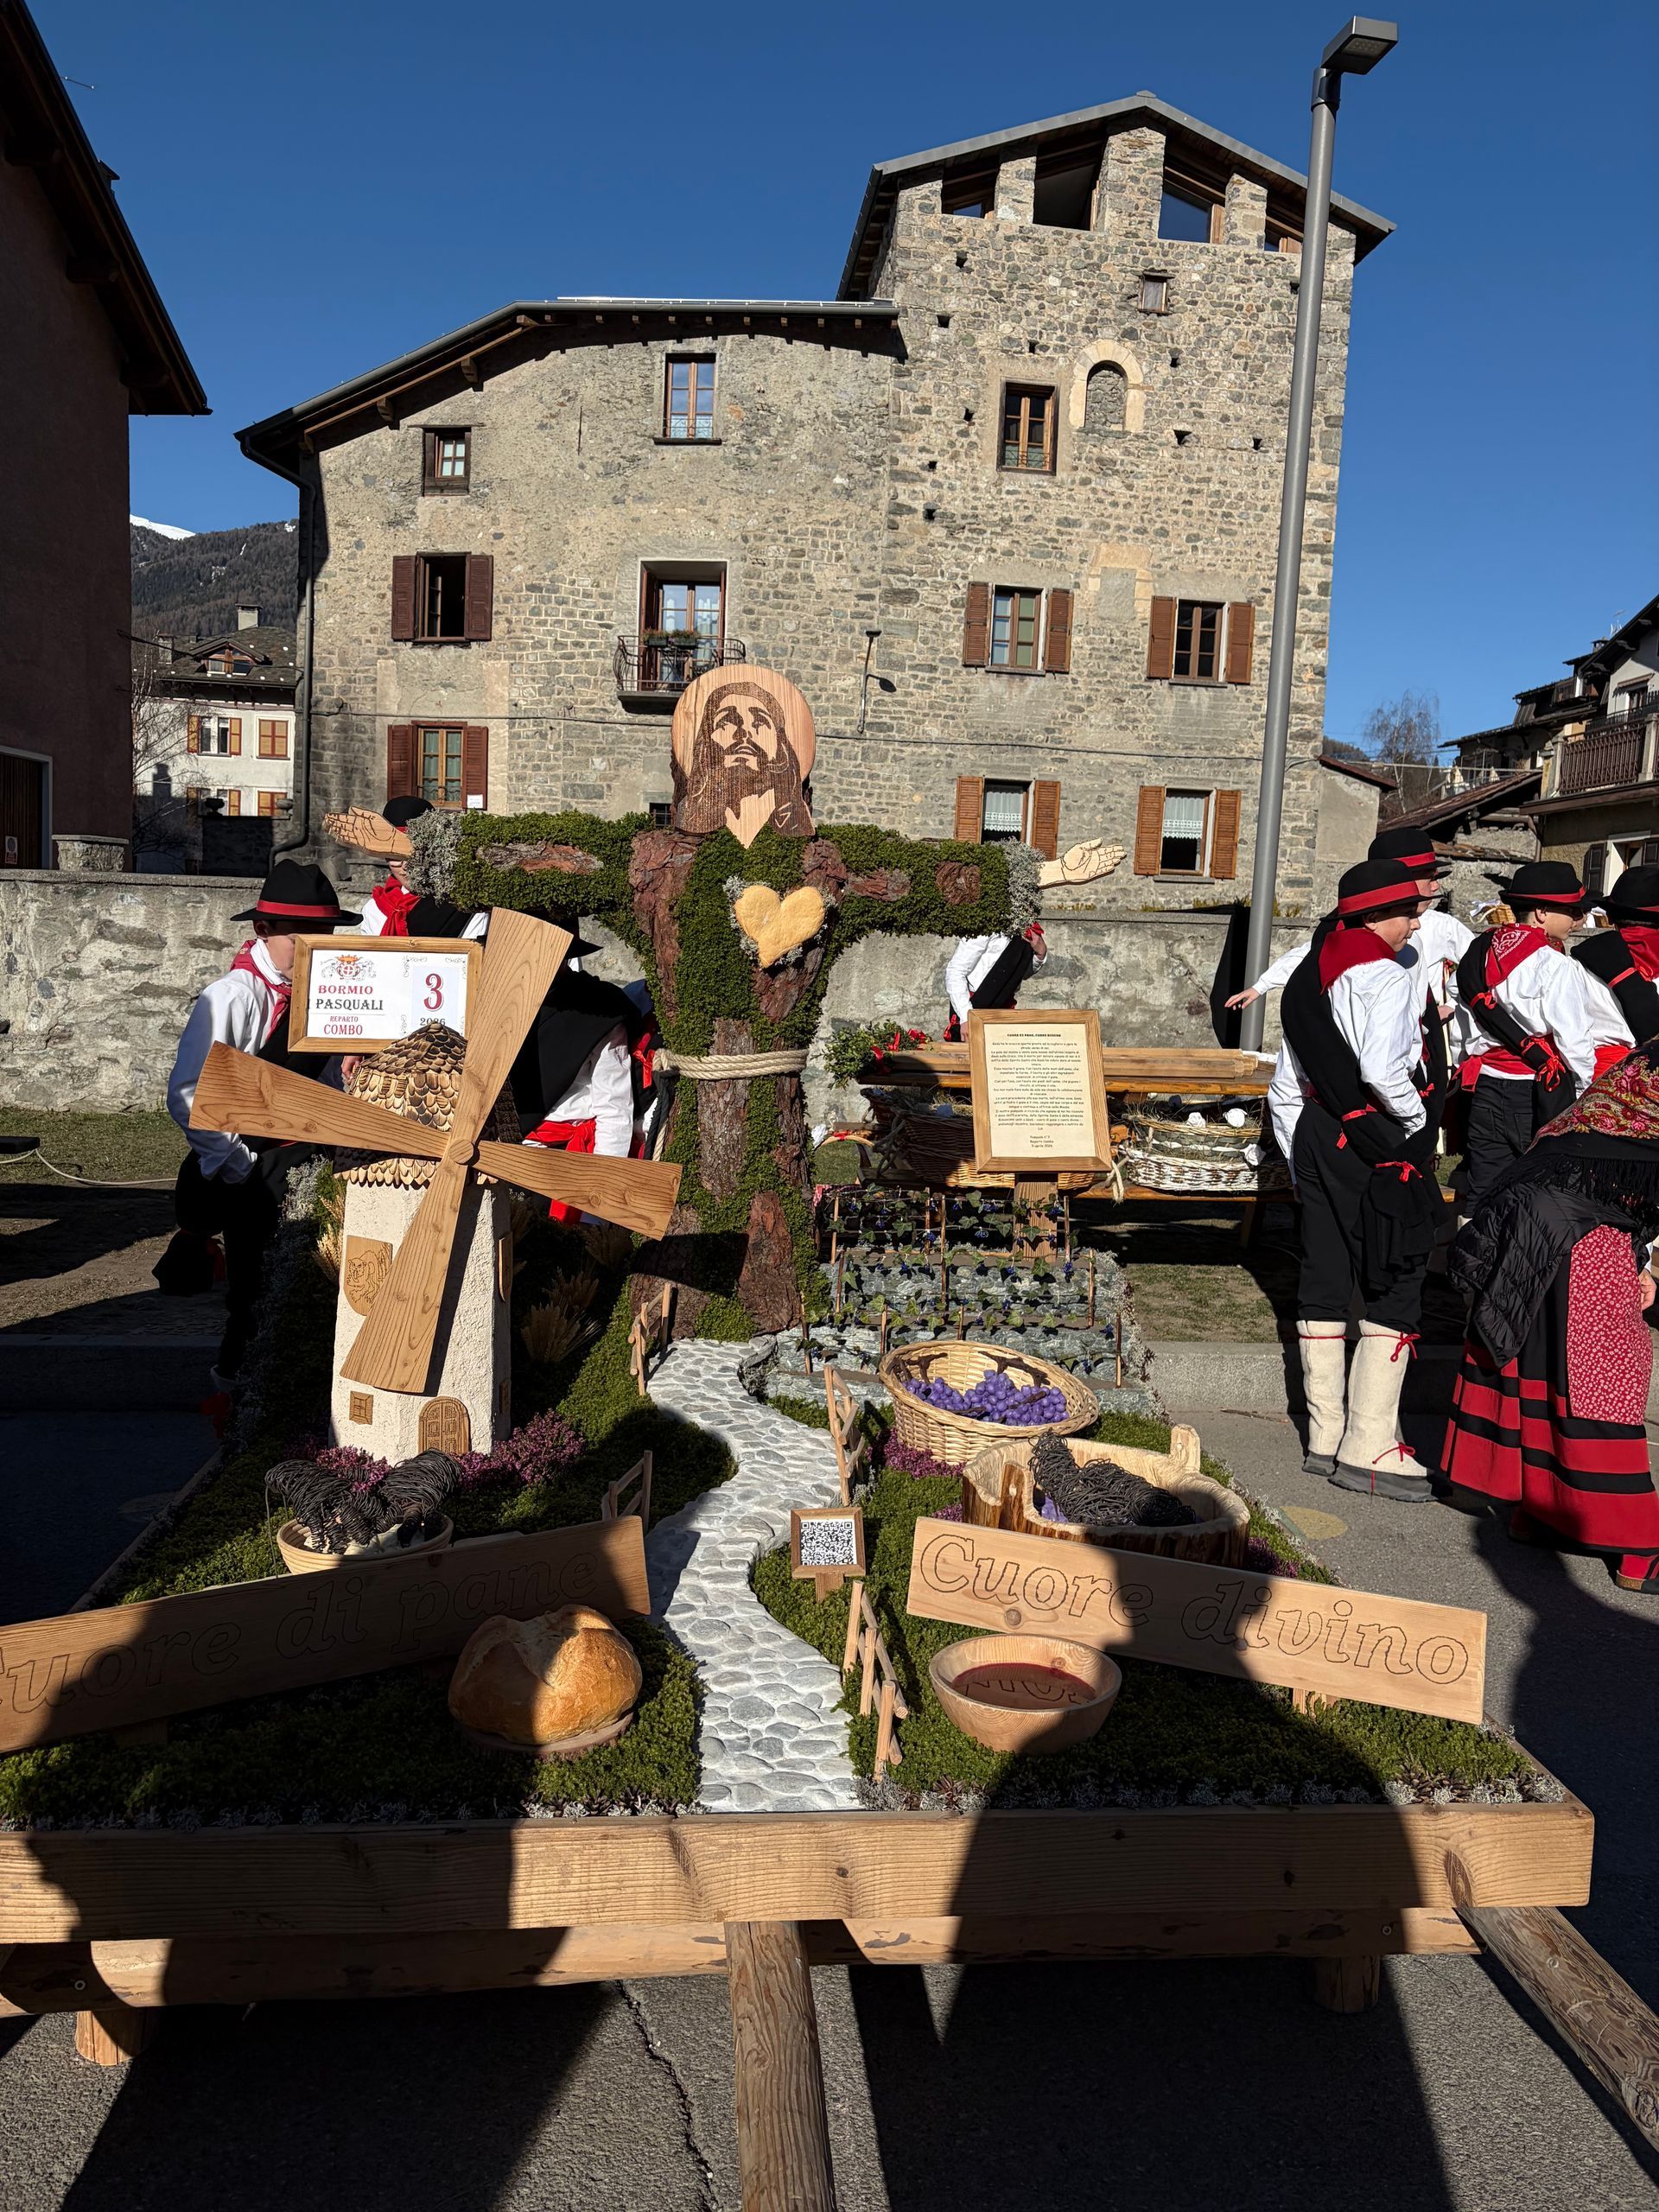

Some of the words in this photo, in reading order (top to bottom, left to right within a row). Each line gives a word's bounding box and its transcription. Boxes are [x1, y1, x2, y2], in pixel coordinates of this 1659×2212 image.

[318, 985, 373, 995] BORMIO
[423, 973, 444, 1012] 3
[315, 999, 384, 1010] PASQUALI
[323, 1024, 363, 1035] COMBO
[920, 1534, 1154, 1626] Cuore
[1180, 1580, 1469, 1685] divino
[0, 1624, 242, 1713] uore
[276, 1578, 369, 1660] di
[391, 1551, 600, 1654] pane
